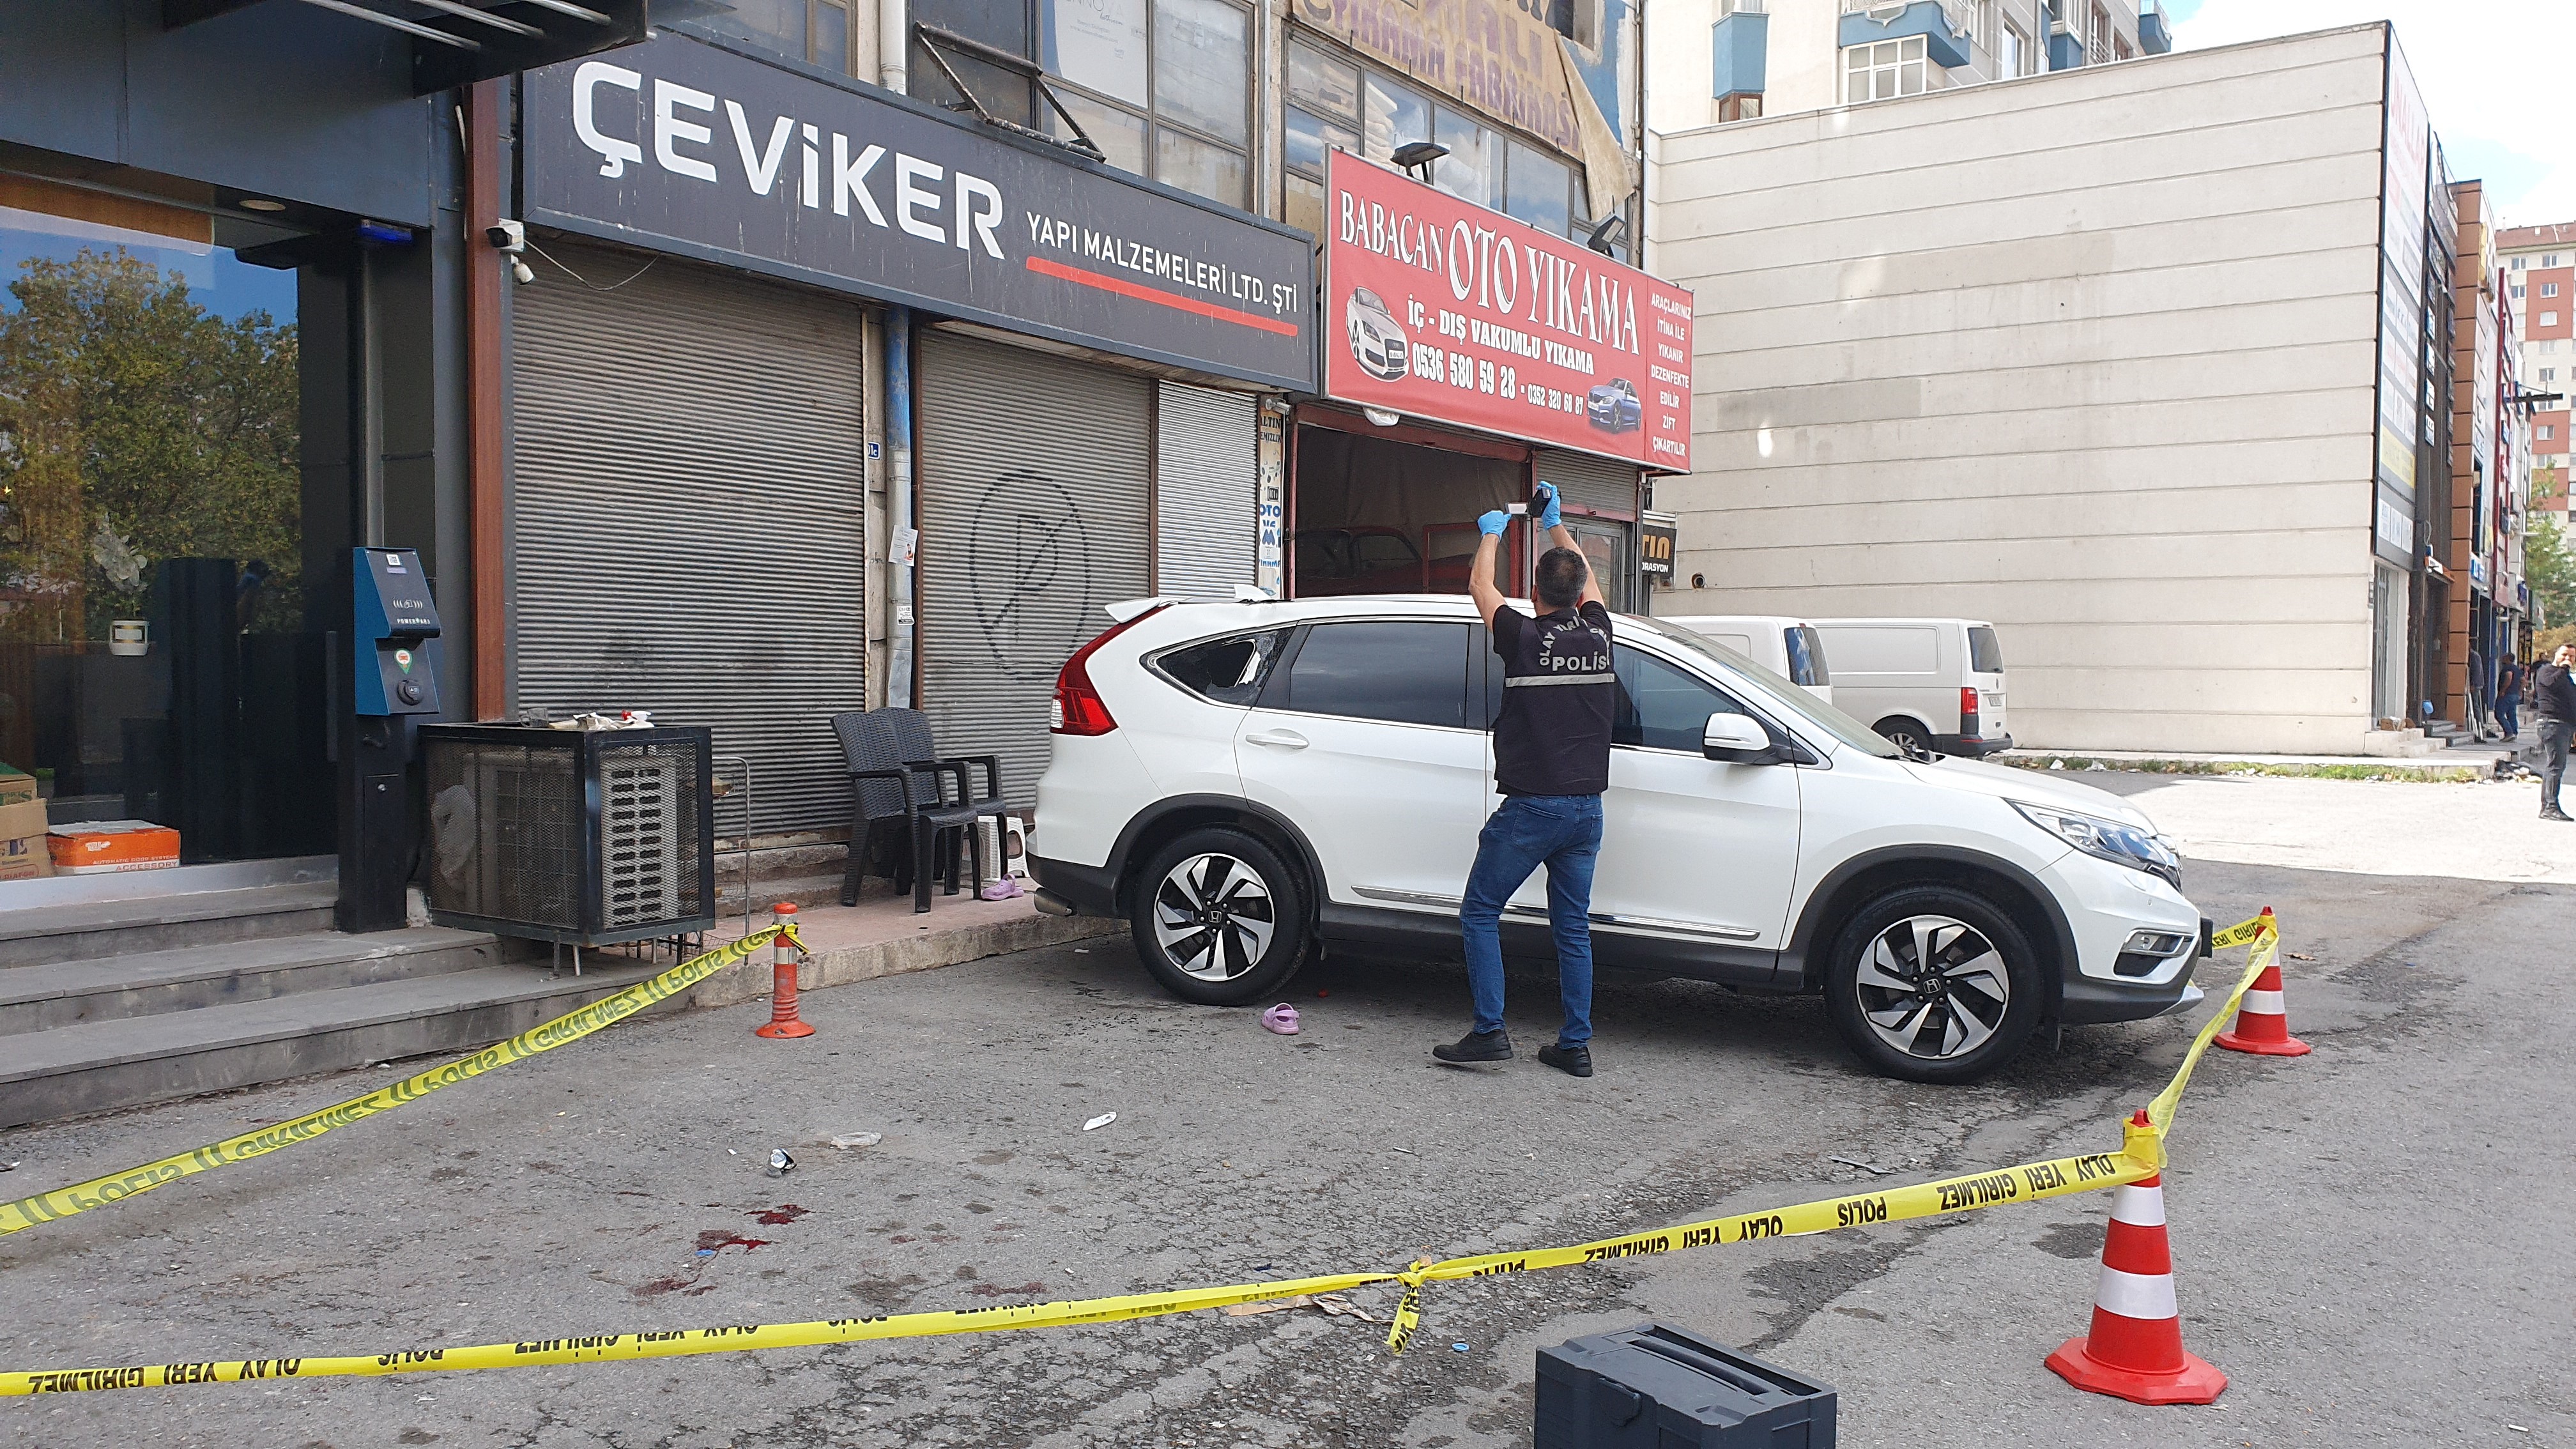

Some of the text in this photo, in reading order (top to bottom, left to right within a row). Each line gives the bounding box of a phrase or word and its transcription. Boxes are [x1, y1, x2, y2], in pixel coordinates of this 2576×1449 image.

[572, 61, 1005, 260] ÇEVİKER
[1026, 211, 1298, 314] YAPI MALZEMELERİ LTD. ŞTİ
[1339, 189, 1640, 356] BABACAN OTO YIKAMA
[1651, 293, 1692, 321] ARAÇLARINIZ
[1407, 293, 1425, 334] İÇ
[1439, 309, 1467, 346] DIŞ
[1470, 318, 1542, 360] VAKUMLU
[1544, 339, 1595, 376] YIKAMA
[1657, 315, 1685, 341] İTİNA İLE
[1658, 342, 1684, 364] YIKANIR
[1412, 341, 1445, 383] 0536
[1449, 351, 1474, 391] 580
[1479, 358, 1495, 395] 59
[1499, 365, 1516, 401] 28
[1528, 383, 1546, 408] 0352
[1548, 388, 1561, 411] 320
[1563, 392, 1573, 414] 68
[1575, 395, 1584, 416] 87
[1650, 364, 1690, 389] DEZENFEKTE
[1660, 390, 1680, 410] EDİLİR
[1262, 415, 1281, 429] LTIN
[1662, 413, 1676, 431] ZİFT
[1652, 436, 1686, 457] ÇIKARTILIR
[1552, 650, 1607, 671] POLİS
[116, 861, 178, 871] ACCESSORY
[2074, 1154, 2117, 1182] OLAY
